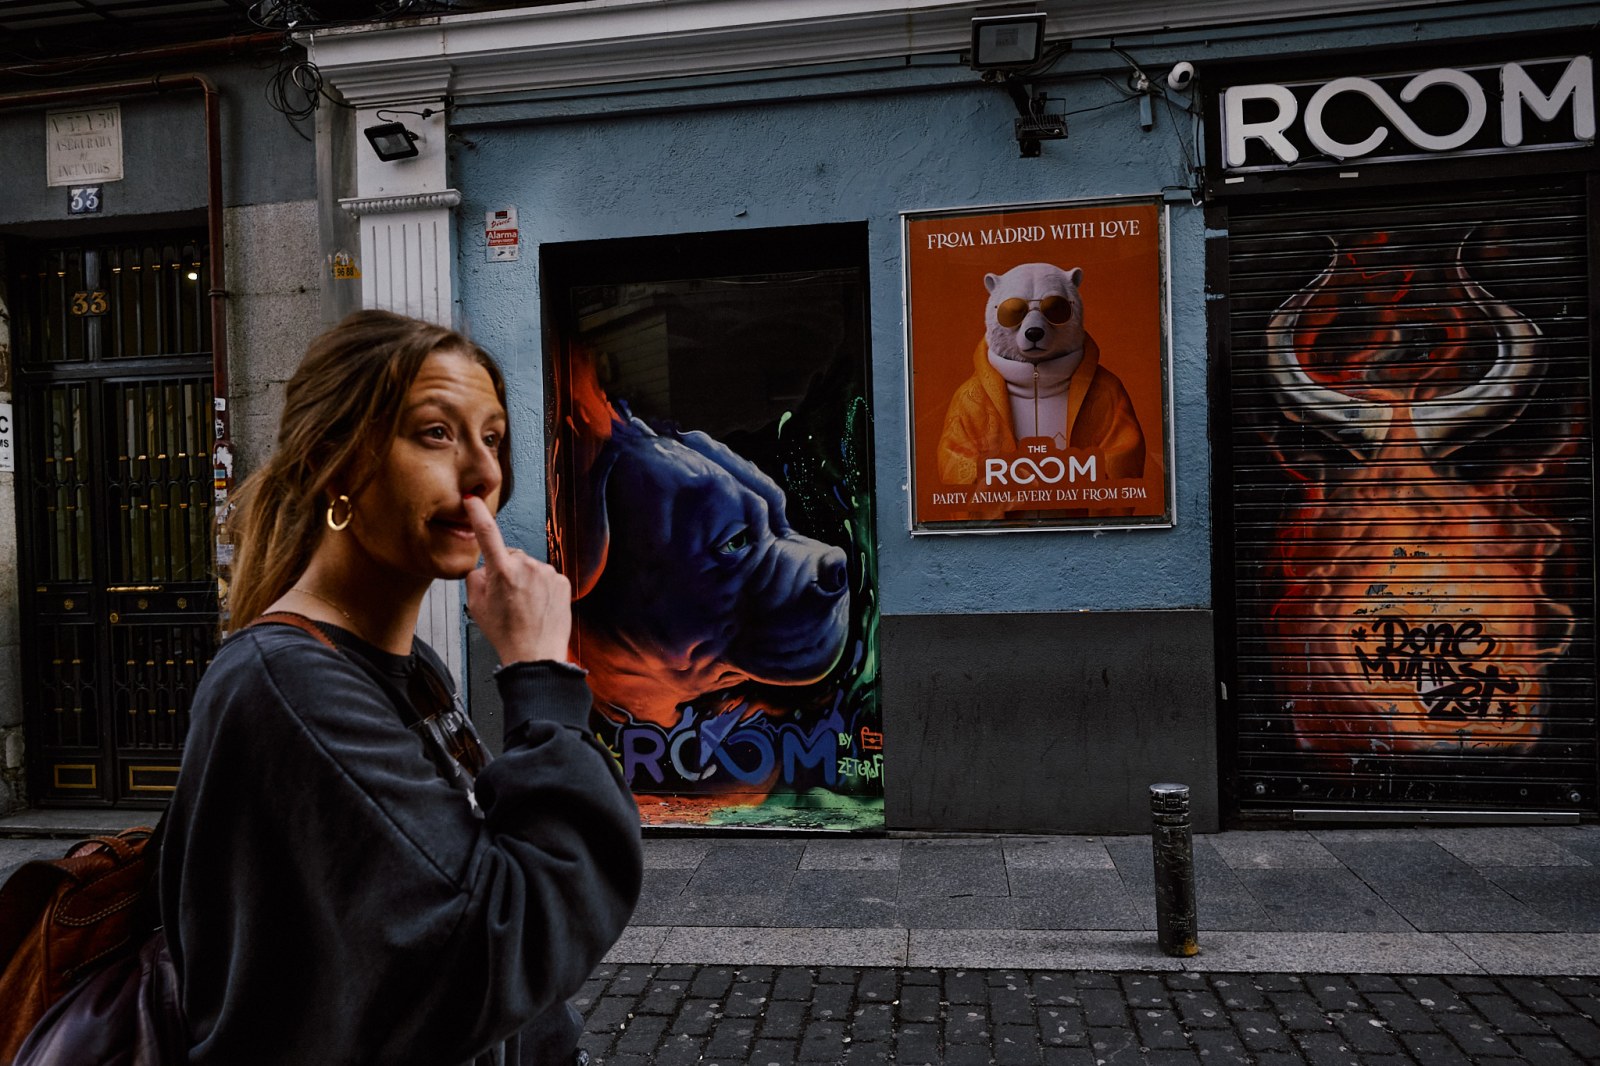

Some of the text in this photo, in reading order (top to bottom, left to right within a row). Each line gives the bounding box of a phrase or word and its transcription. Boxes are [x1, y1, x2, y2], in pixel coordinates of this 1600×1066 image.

[1225, 55, 1596, 167] ROOM
[71, 187, 99, 210] 33
[487, 231, 517, 240] Alarma
[927, 219, 1141, 250] FROM MADRID WITH LOVE
[72, 291, 108, 315] 33
[1027, 444, 1047, 453] THE
[985, 454, 1097, 486] ROOM
[932, 487, 1147, 505] PARTY ANIMAL EVERY DAY FROM 5PM
[837, 732, 853, 750] BY
